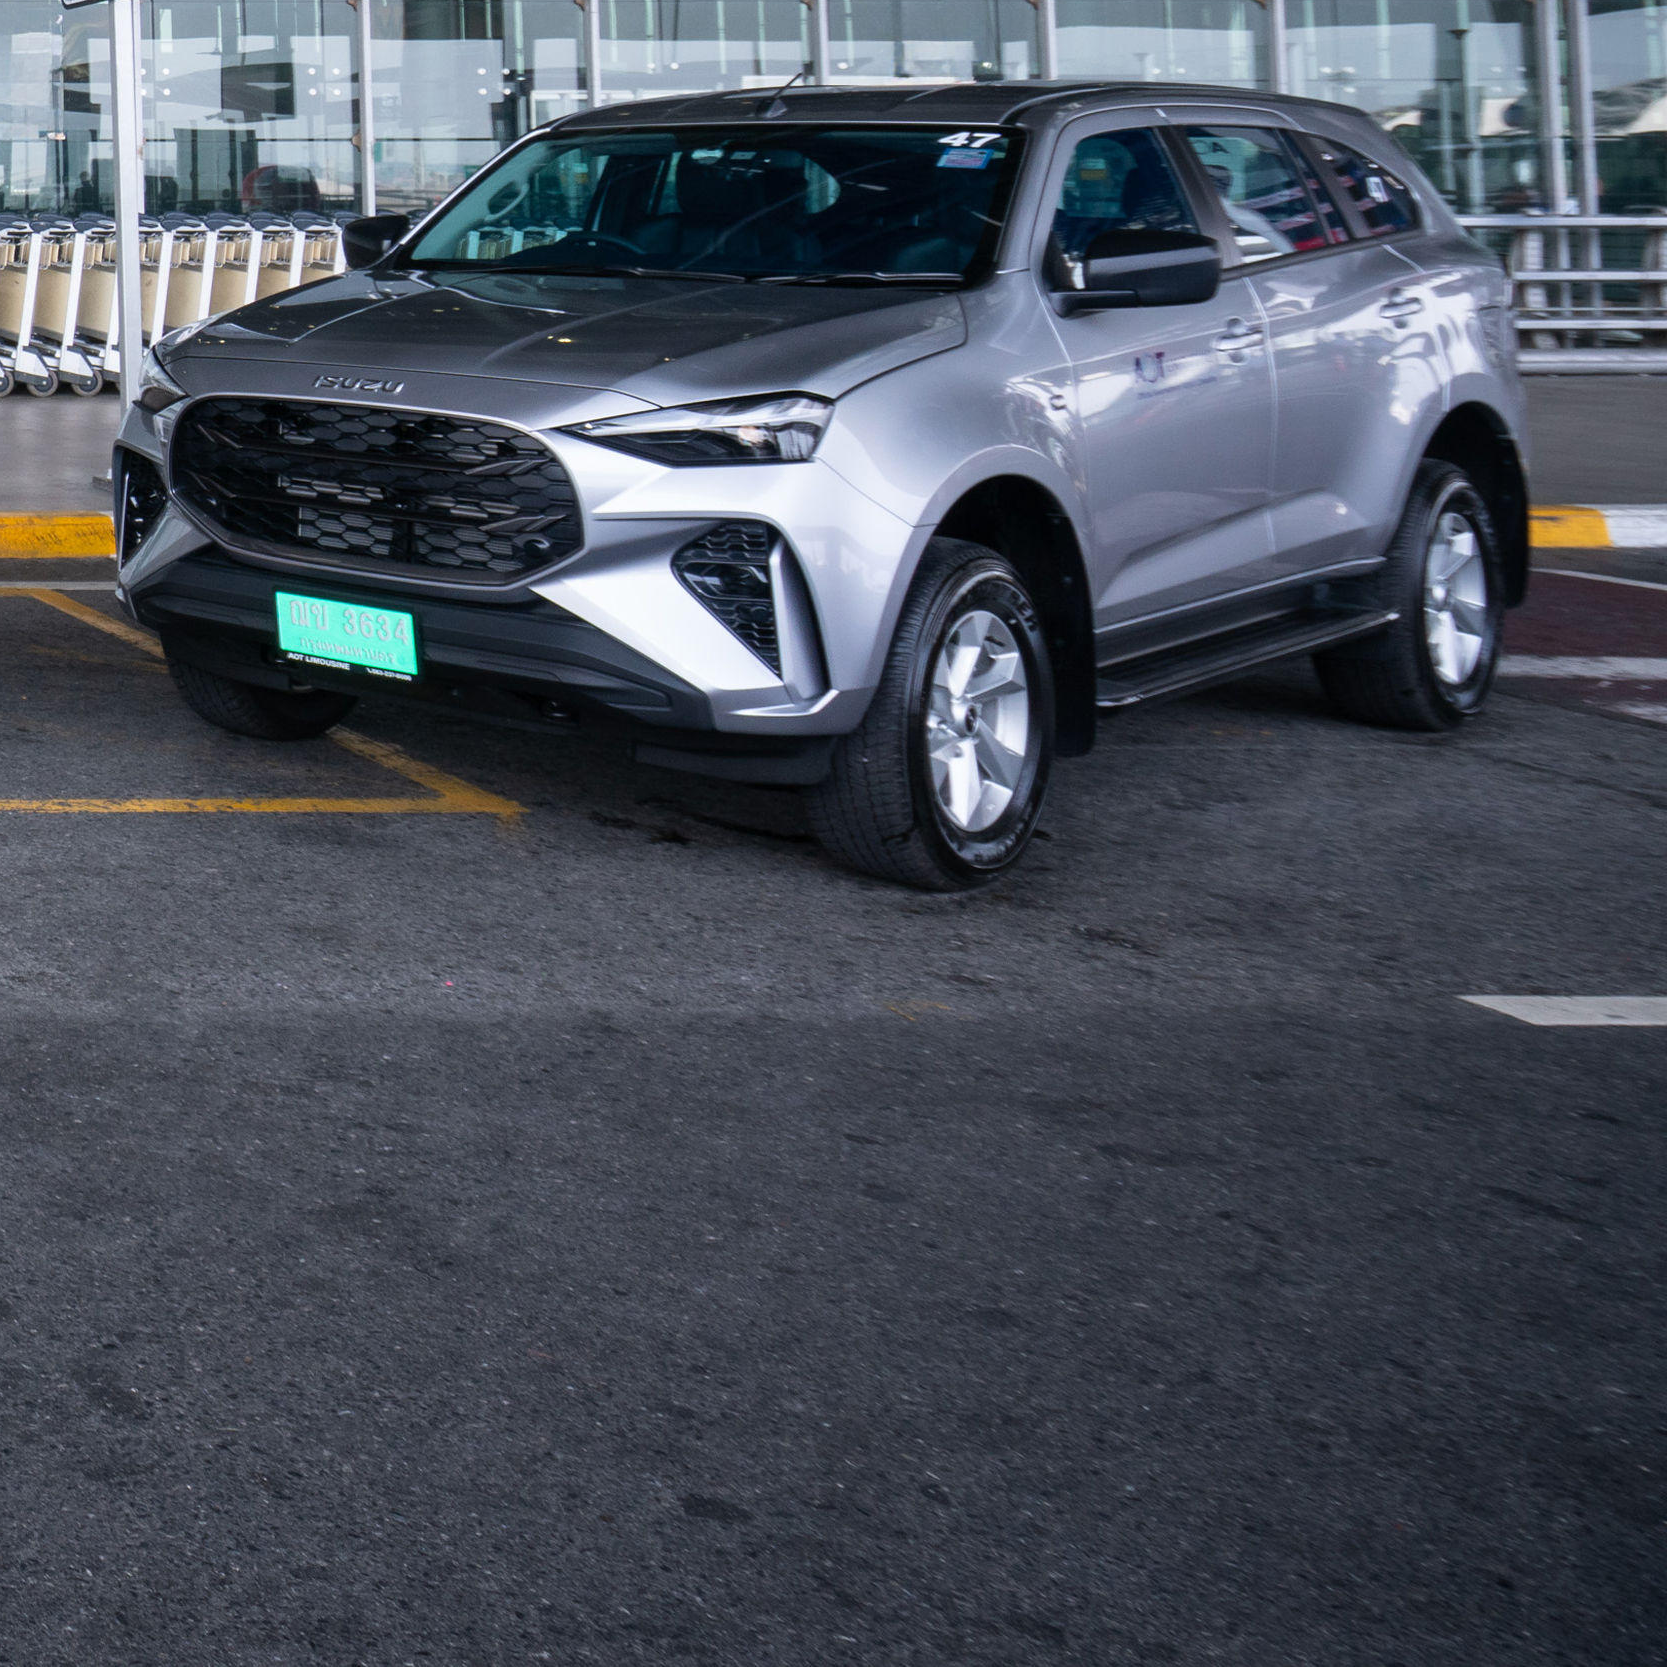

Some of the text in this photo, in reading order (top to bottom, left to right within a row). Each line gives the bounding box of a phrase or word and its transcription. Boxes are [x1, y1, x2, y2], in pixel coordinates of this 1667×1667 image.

[937, 132, 1002, 148] 47
[311, 375, 405, 394] ISUZU
[342, 609, 409, 646] 3634
[299, 637, 397, 665] กรุงเทพมหานคร
[287, 652, 304, 662] AOT
[305, 655, 351, 671] LIMOUSINE
